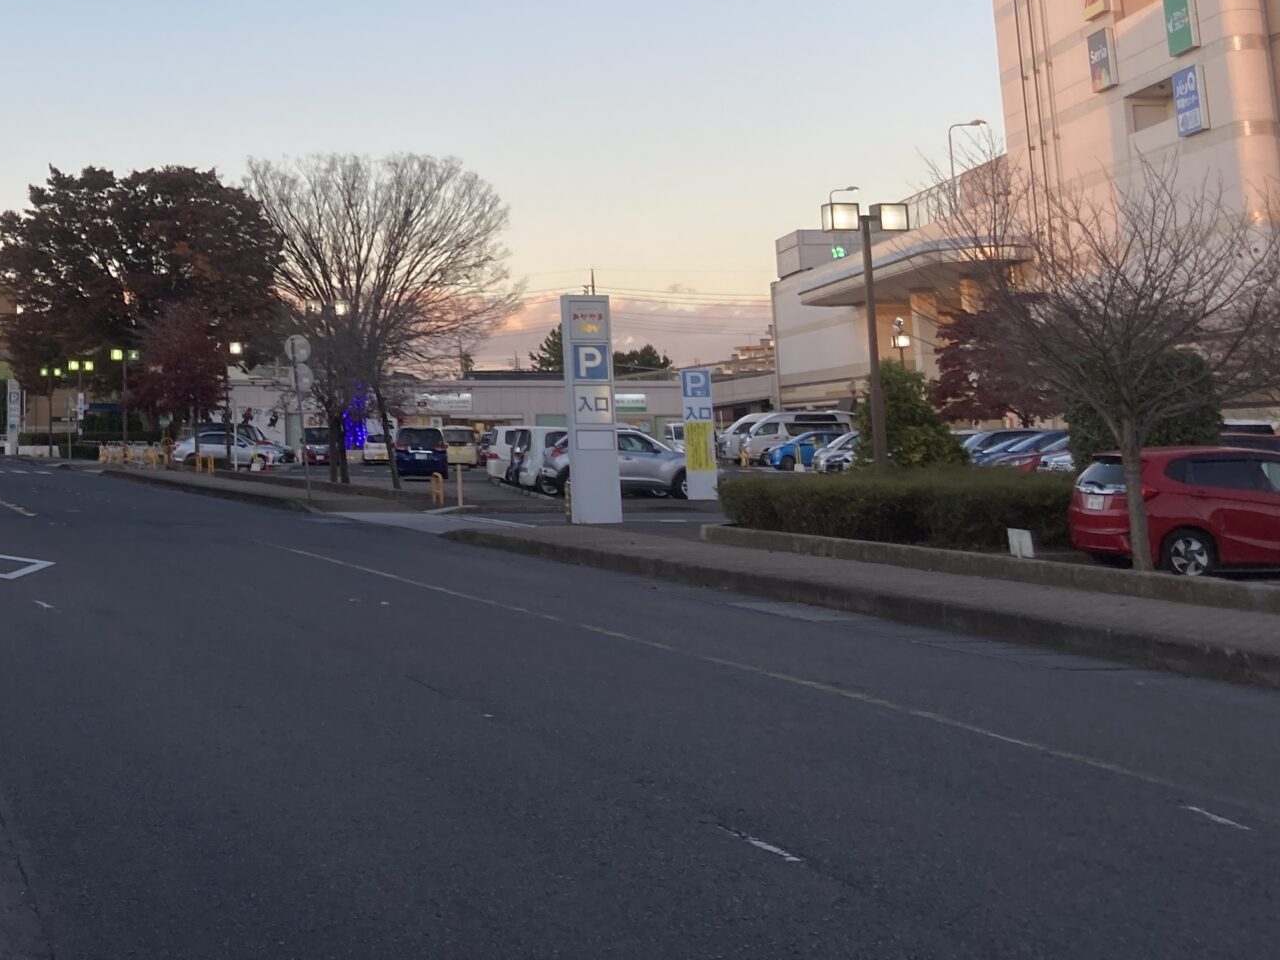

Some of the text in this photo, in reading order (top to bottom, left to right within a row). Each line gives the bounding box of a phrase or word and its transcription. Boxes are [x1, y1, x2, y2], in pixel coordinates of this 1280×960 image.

[578, 346, 602, 378] P
[686, 372, 706, 396] P
[578, 396, 609, 412] 入口
[686, 407, 712, 420] 入口
